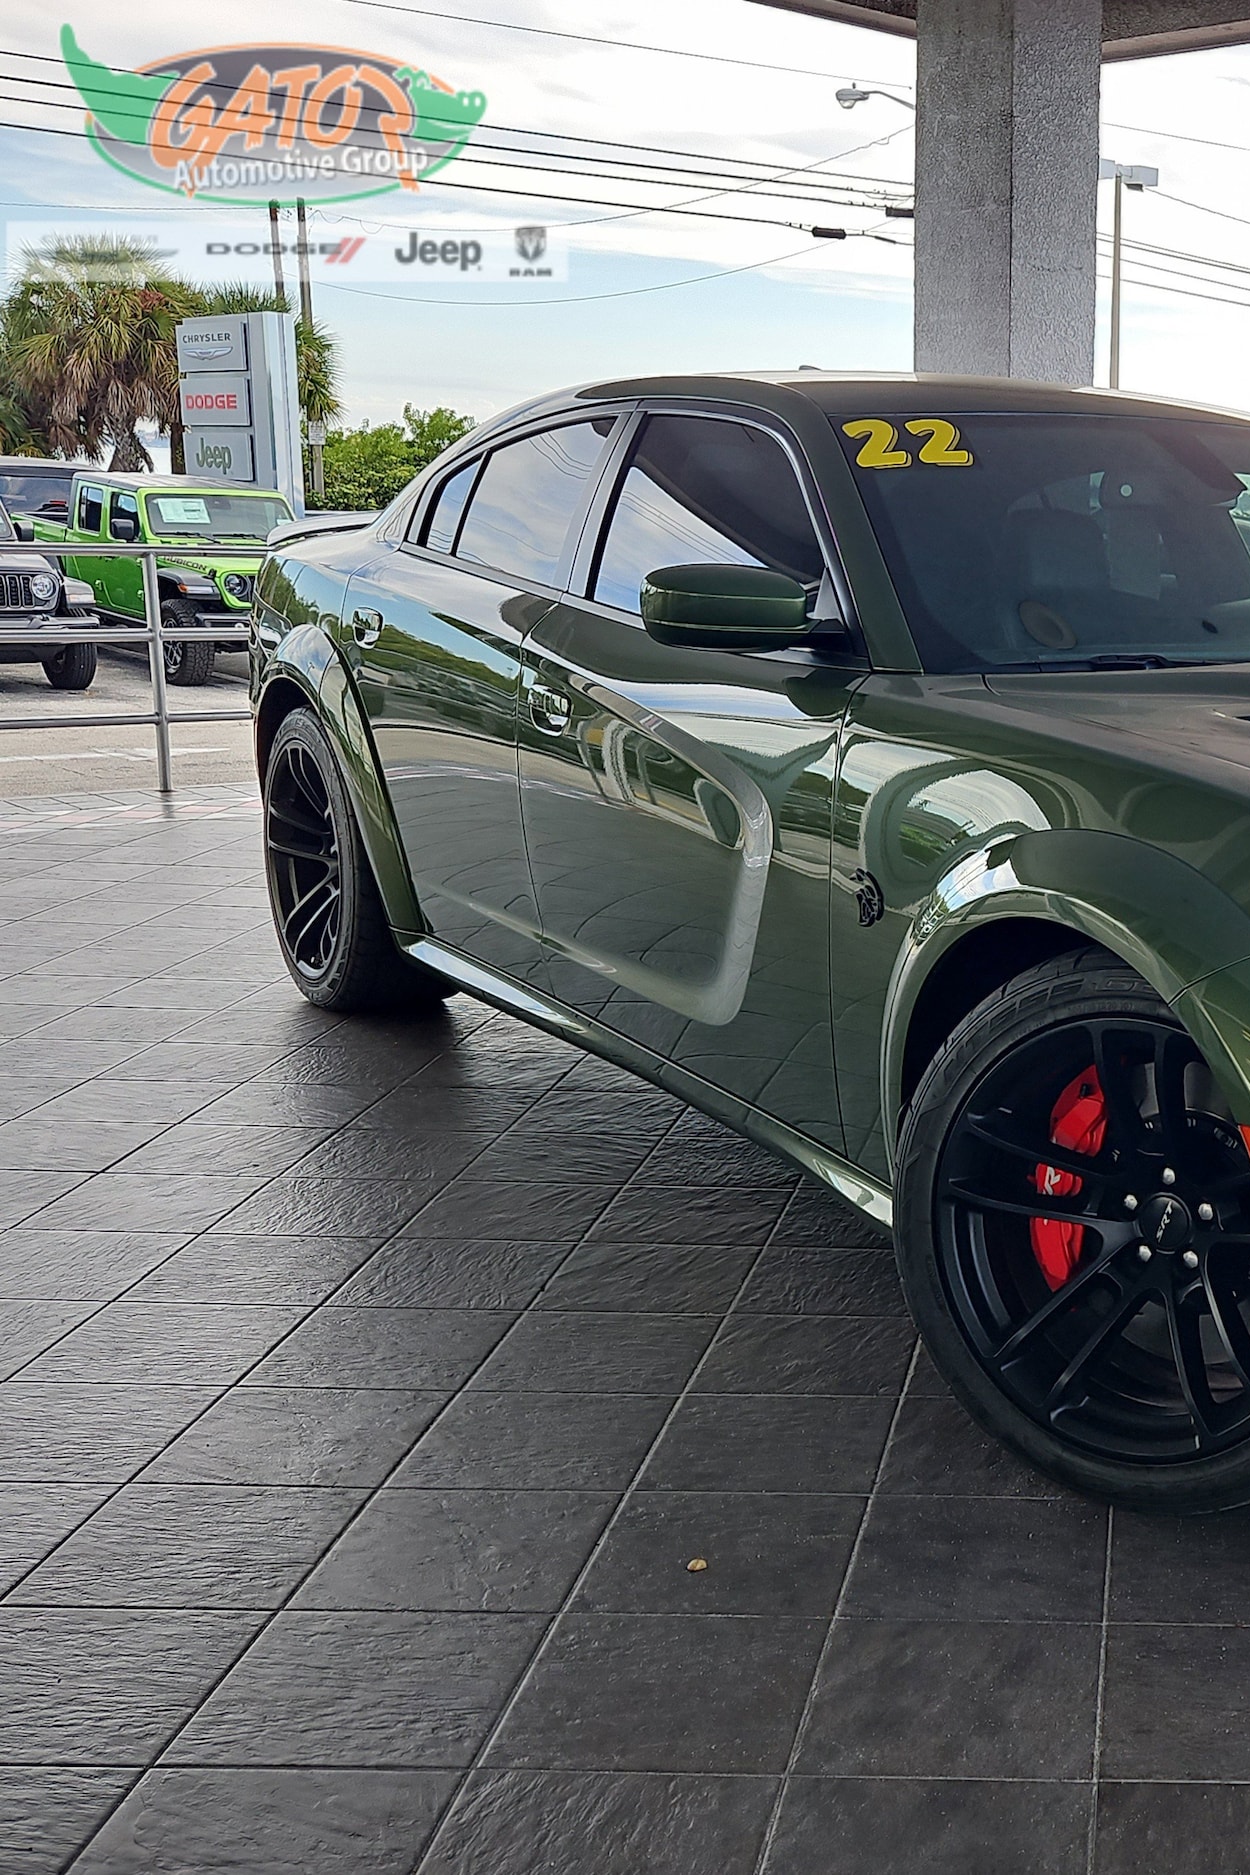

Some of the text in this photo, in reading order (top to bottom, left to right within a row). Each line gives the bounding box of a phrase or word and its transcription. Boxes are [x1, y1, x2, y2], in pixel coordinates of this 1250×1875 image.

[182, 332, 231, 344] CHRYSLER
[185, 394, 238, 410] DODGE
[196, 437, 232, 475] Jeep
[841, 418, 974, 470] 22
